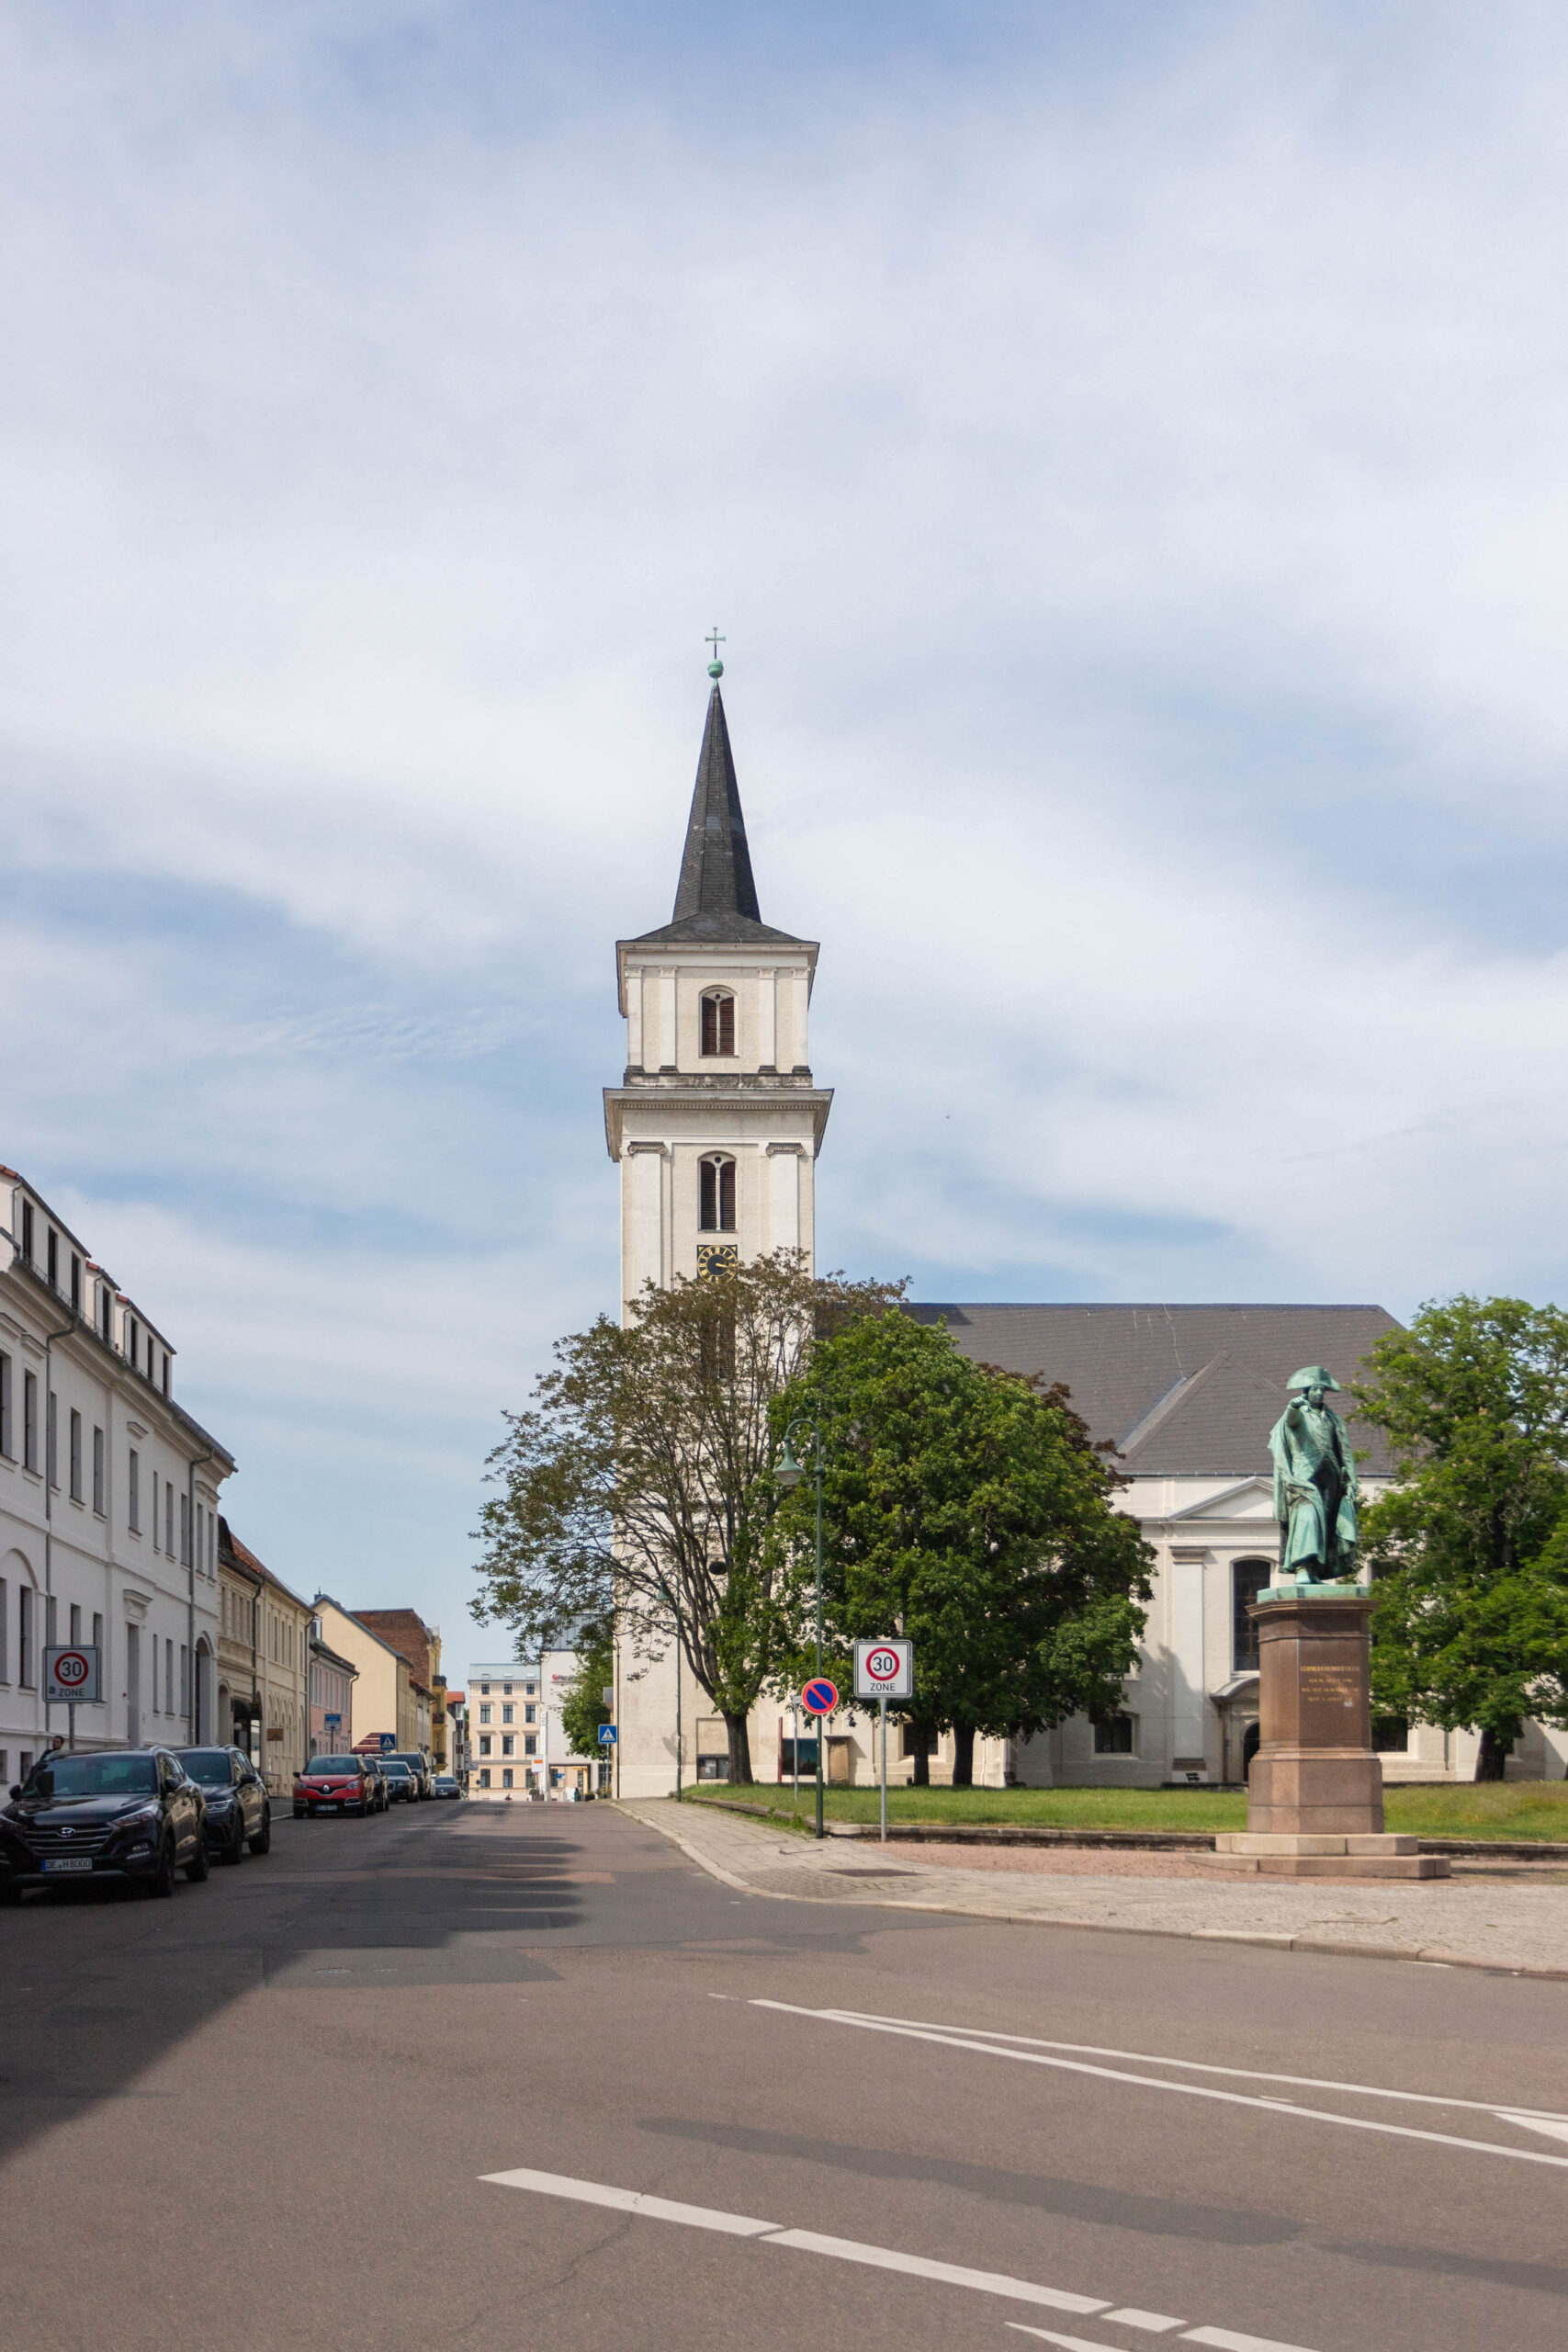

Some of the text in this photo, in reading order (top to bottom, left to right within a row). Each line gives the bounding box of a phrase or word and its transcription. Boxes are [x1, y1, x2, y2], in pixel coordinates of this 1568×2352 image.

[62, 1661, 82, 1677] 30
[873, 1657, 893, 1672] 30
[58, 1688, 85, 1697] ZONE
[870, 1682, 896, 1691] ZONE
